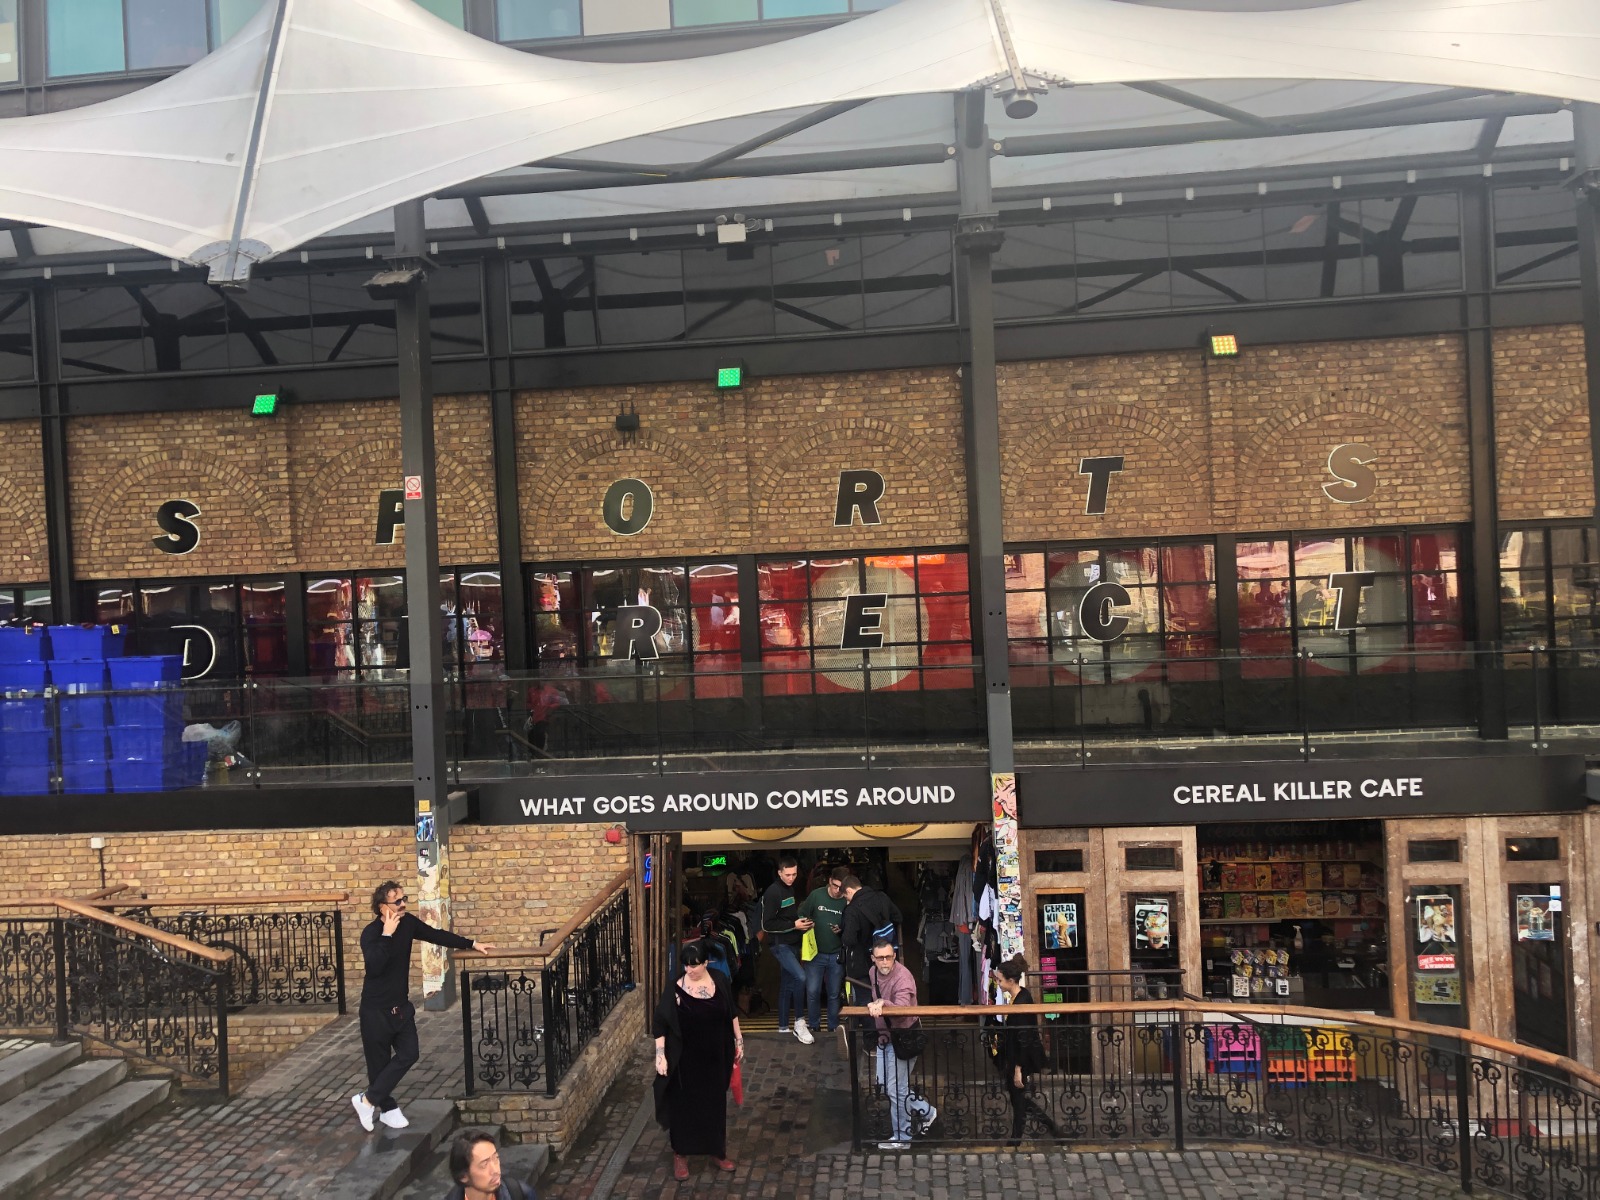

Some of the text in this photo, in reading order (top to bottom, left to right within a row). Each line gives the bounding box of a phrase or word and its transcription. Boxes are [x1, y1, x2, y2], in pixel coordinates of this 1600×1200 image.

[152, 499, 202, 555] S
[602, 478, 654, 536] O
[834, 469, 885, 527] R
[1078, 456, 1124, 515] T
[1321, 443, 1378, 503] S
[611, 604, 663, 661] R
[840, 593, 889, 650] E
[1078, 582, 1132, 642] C
[1328, 571, 1375, 631] T
[519, 785, 956, 817] WHAT GOES AROUND COMES AROUND
[1173, 777, 1424, 805] CEREAL KILLER CAFE
[1045, 904, 1075, 913] CEREAL
[1047, 913, 1075, 922] KIER
